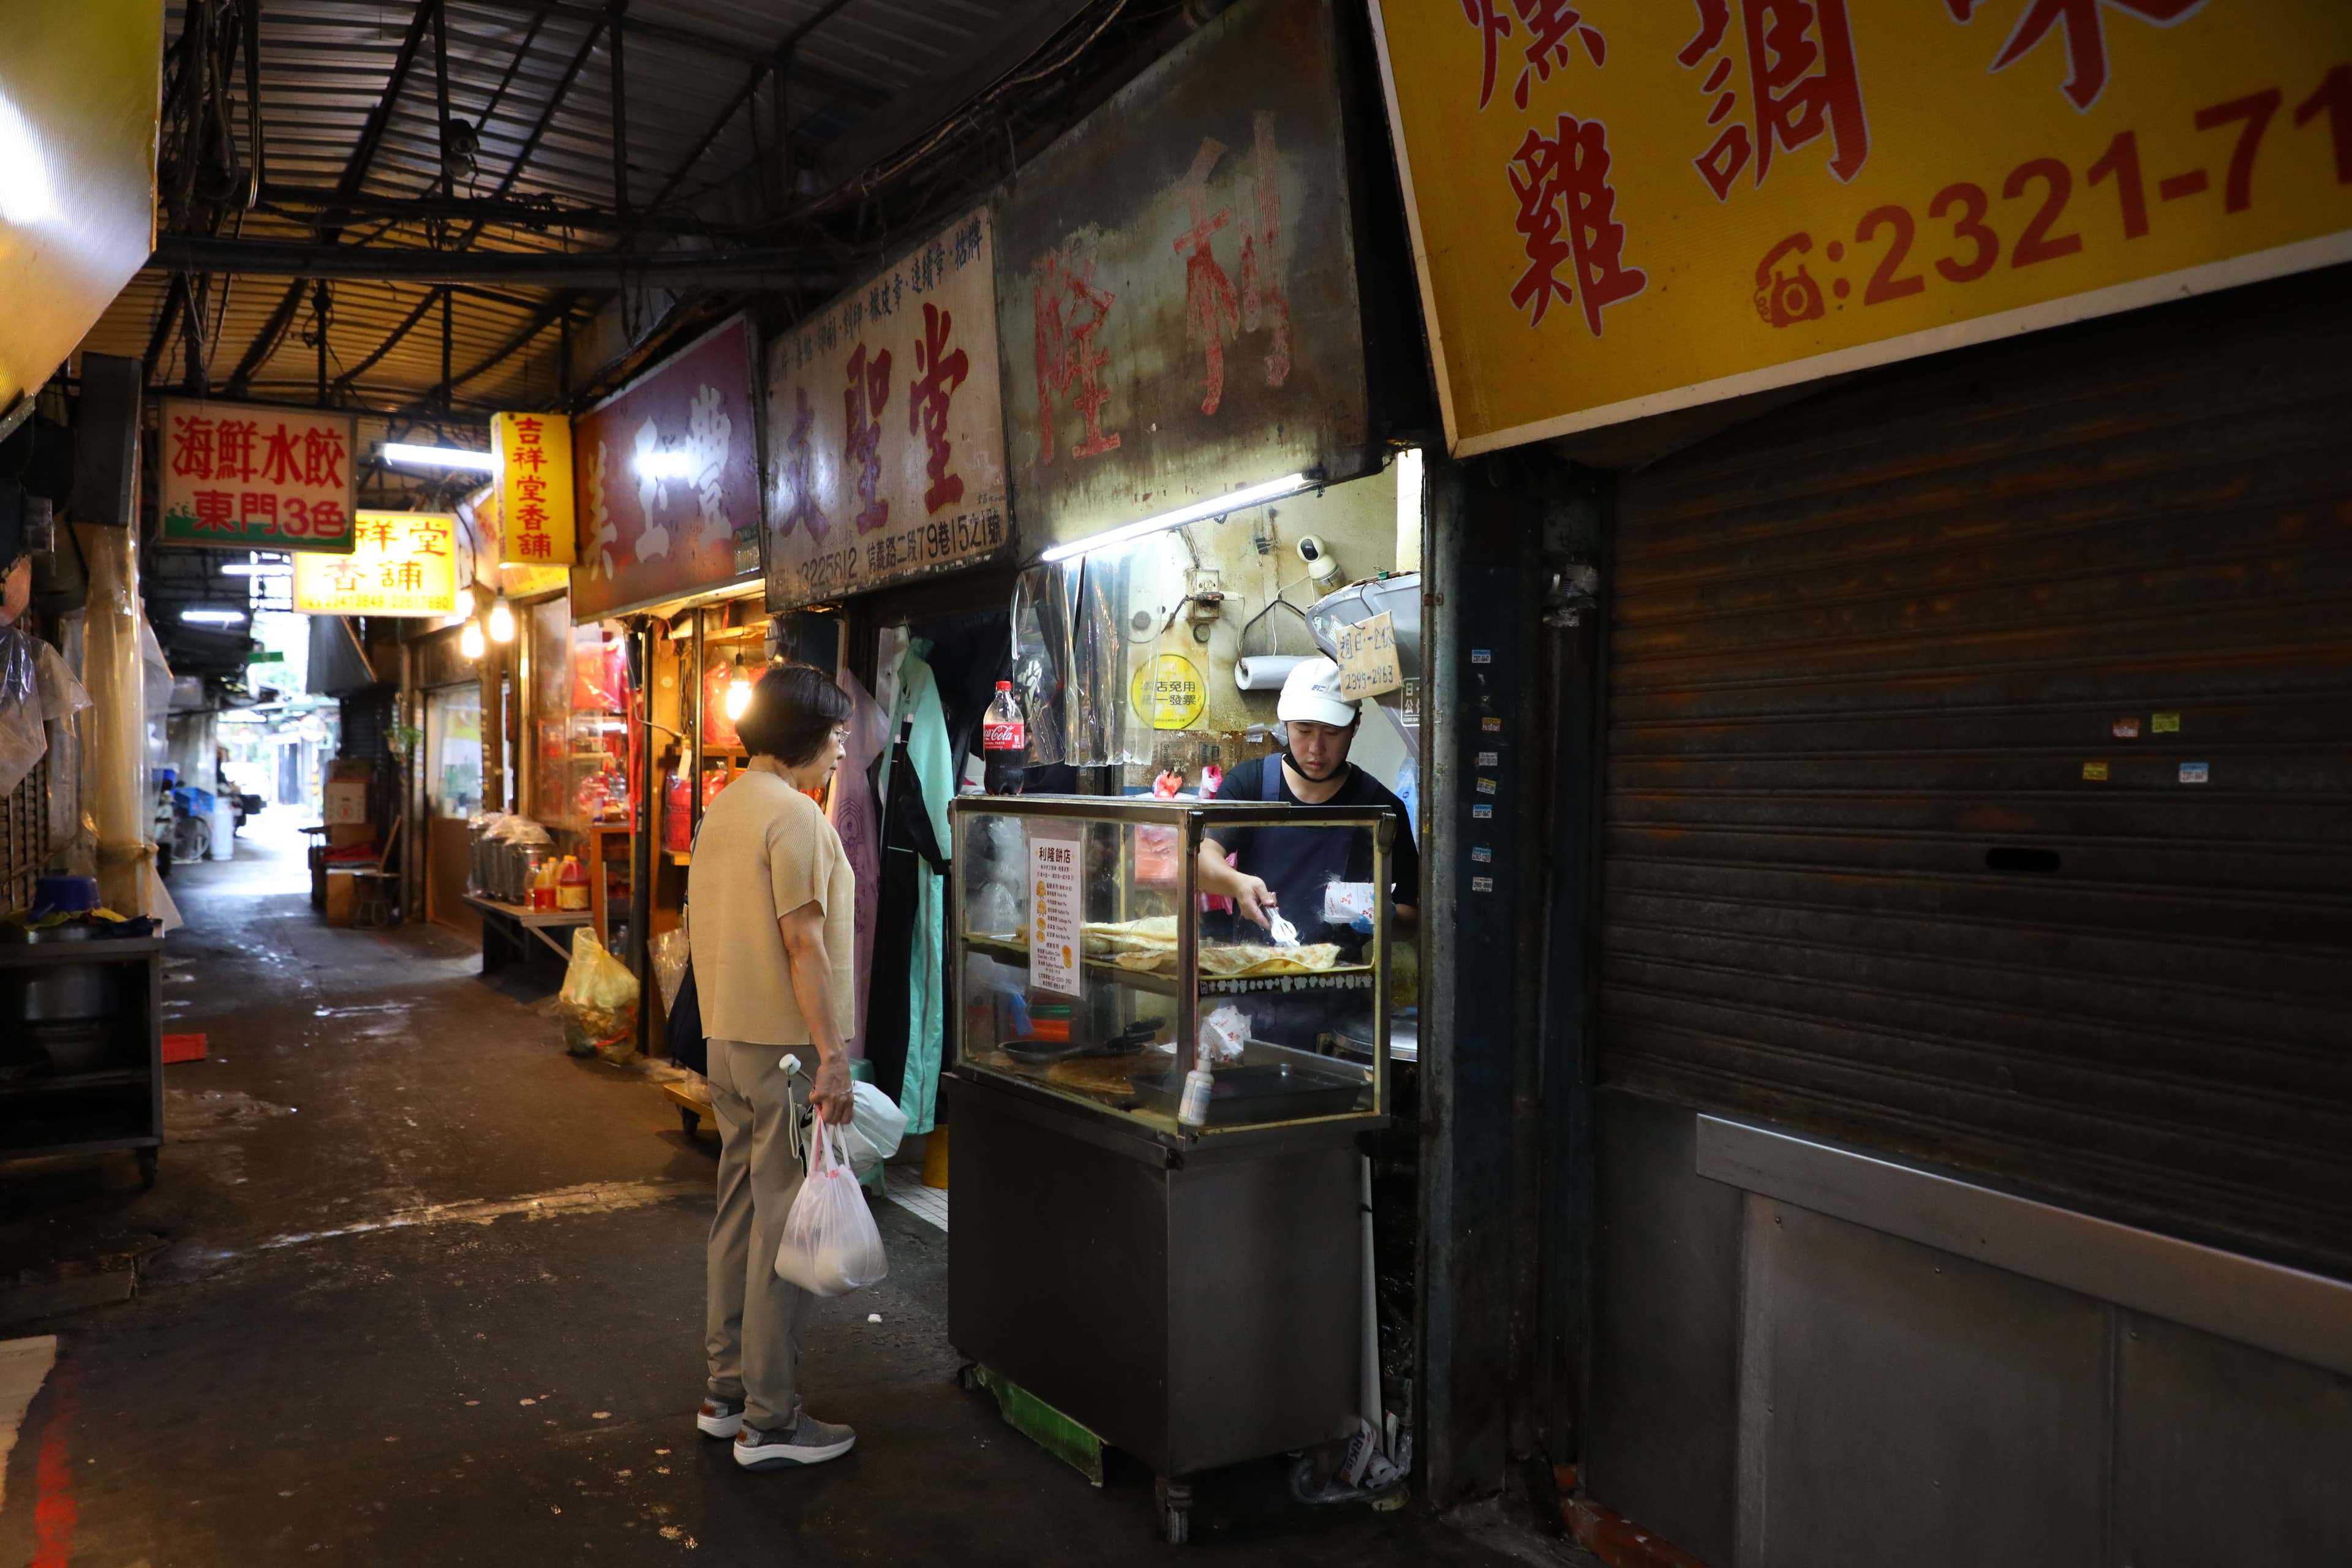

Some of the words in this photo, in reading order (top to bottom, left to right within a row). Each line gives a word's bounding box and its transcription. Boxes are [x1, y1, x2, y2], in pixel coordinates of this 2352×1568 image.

[955, 217, 983, 271] 招牌
[780, 302, 969, 545] 文聖堂
[172, 415, 345, 489] 海鮮水餃
[192, 489, 347, 539] 東門3色
[1039, 846, 1070, 863] 利隆餅店
